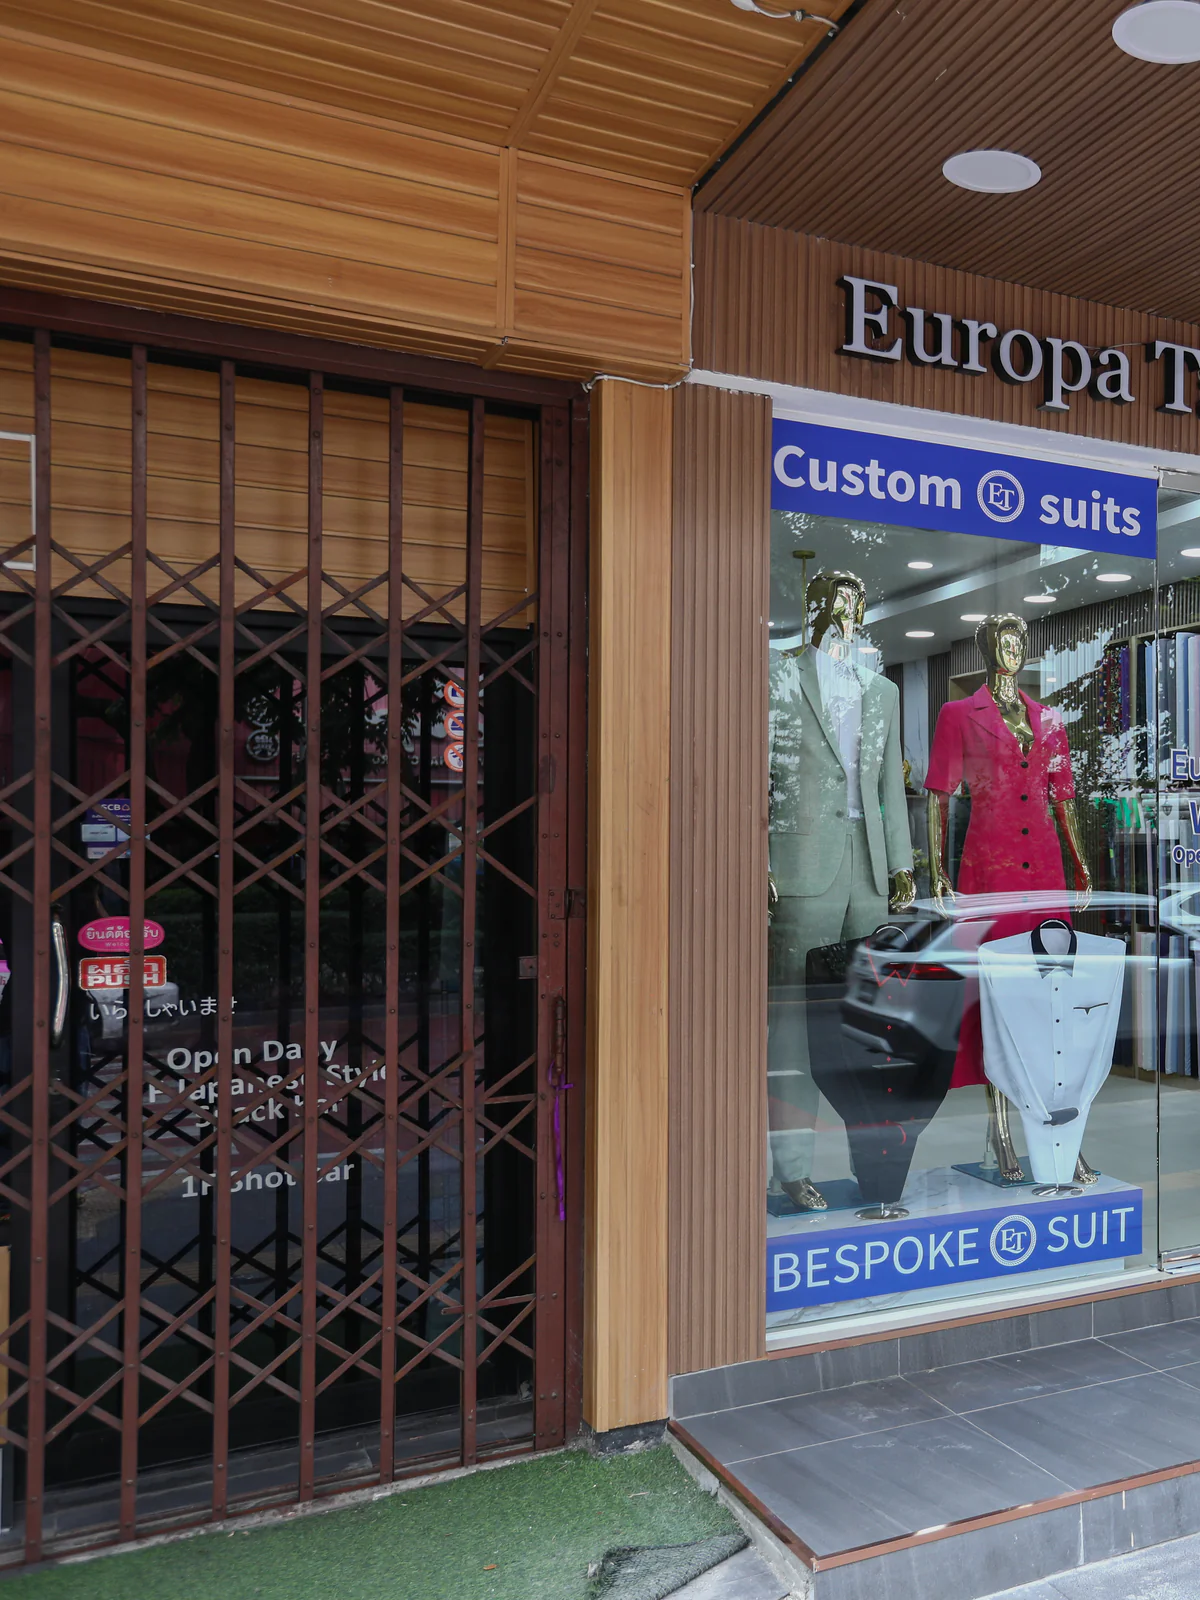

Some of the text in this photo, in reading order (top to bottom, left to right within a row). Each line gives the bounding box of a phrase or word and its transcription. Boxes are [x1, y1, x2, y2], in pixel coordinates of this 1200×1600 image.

[838, 275, 1135, 411] Europa
[773, 444, 962, 510] Custom
[1039, 489, 1141, 537] suits
[89, 996, 238, 1020] いらしゃいま
[263, 1040, 338, 1062] Day
[177, 1071, 306, 1104] Japanes
[195, 1097, 285, 1128] Sack
[314, 1163, 355, 1184] ar
[773, 1227, 980, 1294] BESPOKE
[1047, 1206, 1135, 1253] SUIT
